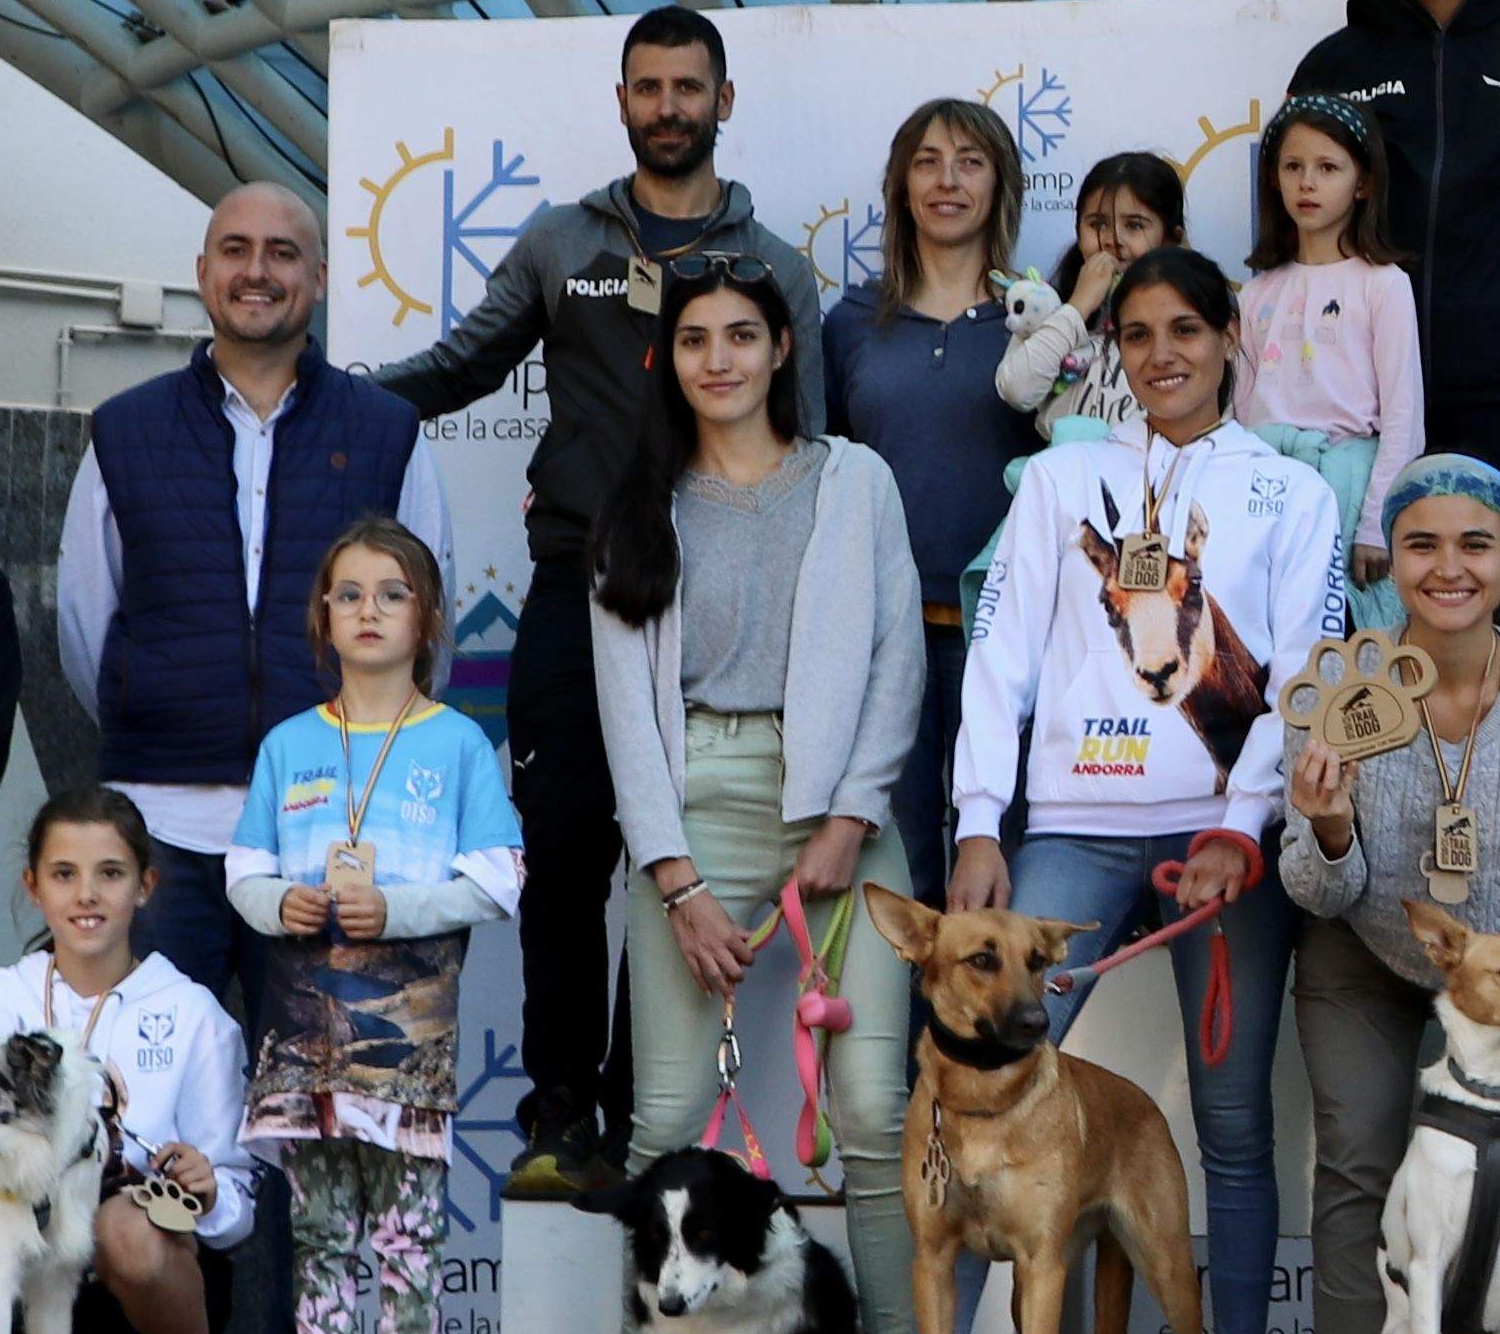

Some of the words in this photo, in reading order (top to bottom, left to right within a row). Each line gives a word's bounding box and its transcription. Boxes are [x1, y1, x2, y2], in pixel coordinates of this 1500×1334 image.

[1022, 172, 1074, 197] amp
[566, 278, 629, 298] POLICIA
[423, 417, 458, 441] de
[466, 411, 487, 440] la
[1248, 498, 1284, 515] OTSO
[1135, 571, 1160, 586] DOG
[1350, 707, 1377, 724] TRAIL
[1084, 717, 1151, 736] TRAIL
[1354, 719, 1381, 739] DOG
[1077, 736, 1151, 763] RUN
[1072, 763, 1145, 776] ANDORRA
[401, 800, 437, 826] OTSO
[1451, 849, 1472, 866] DOG
[137, 1047, 173, 1067] OTSO
